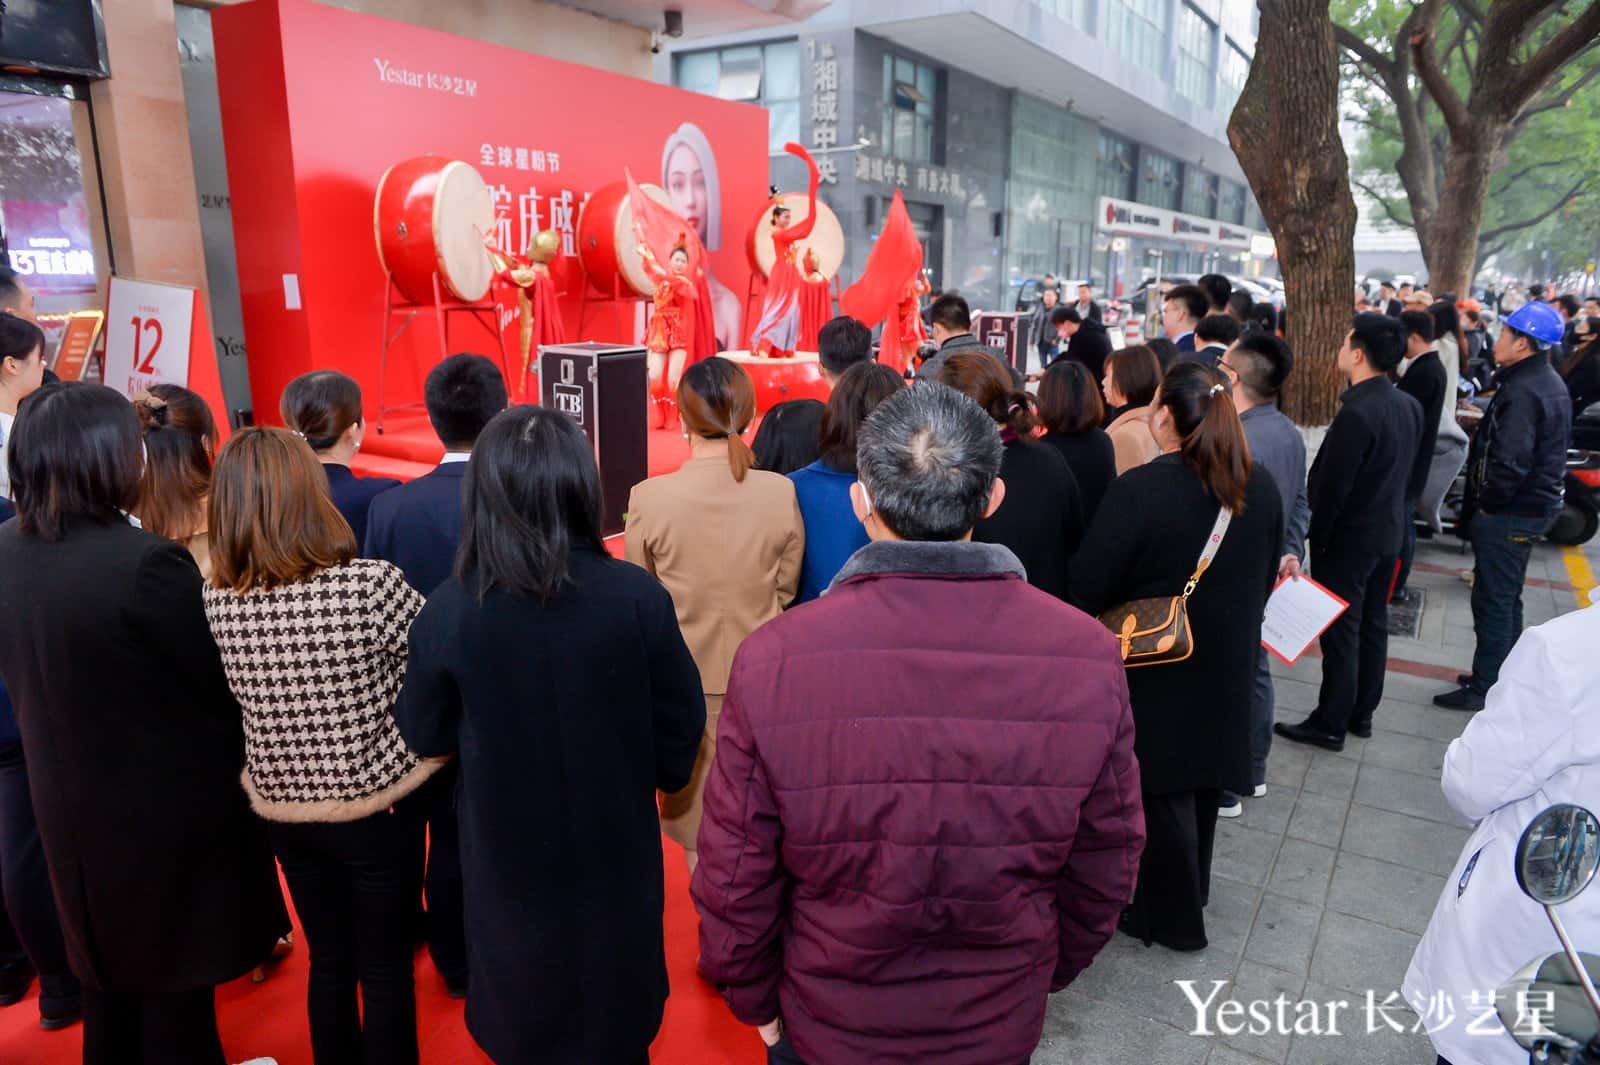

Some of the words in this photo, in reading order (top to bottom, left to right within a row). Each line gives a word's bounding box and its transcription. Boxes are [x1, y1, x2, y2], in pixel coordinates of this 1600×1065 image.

[373, 57, 424, 88] Yestar
[426, 71, 478, 97] 长沙艺星
[812, 61, 838, 184] 湘域中央
[479, 143, 560, 172] 全球星粉节
[487, 184, 591, 257] 院庆盛
[131, 315, 163, 374] 12
